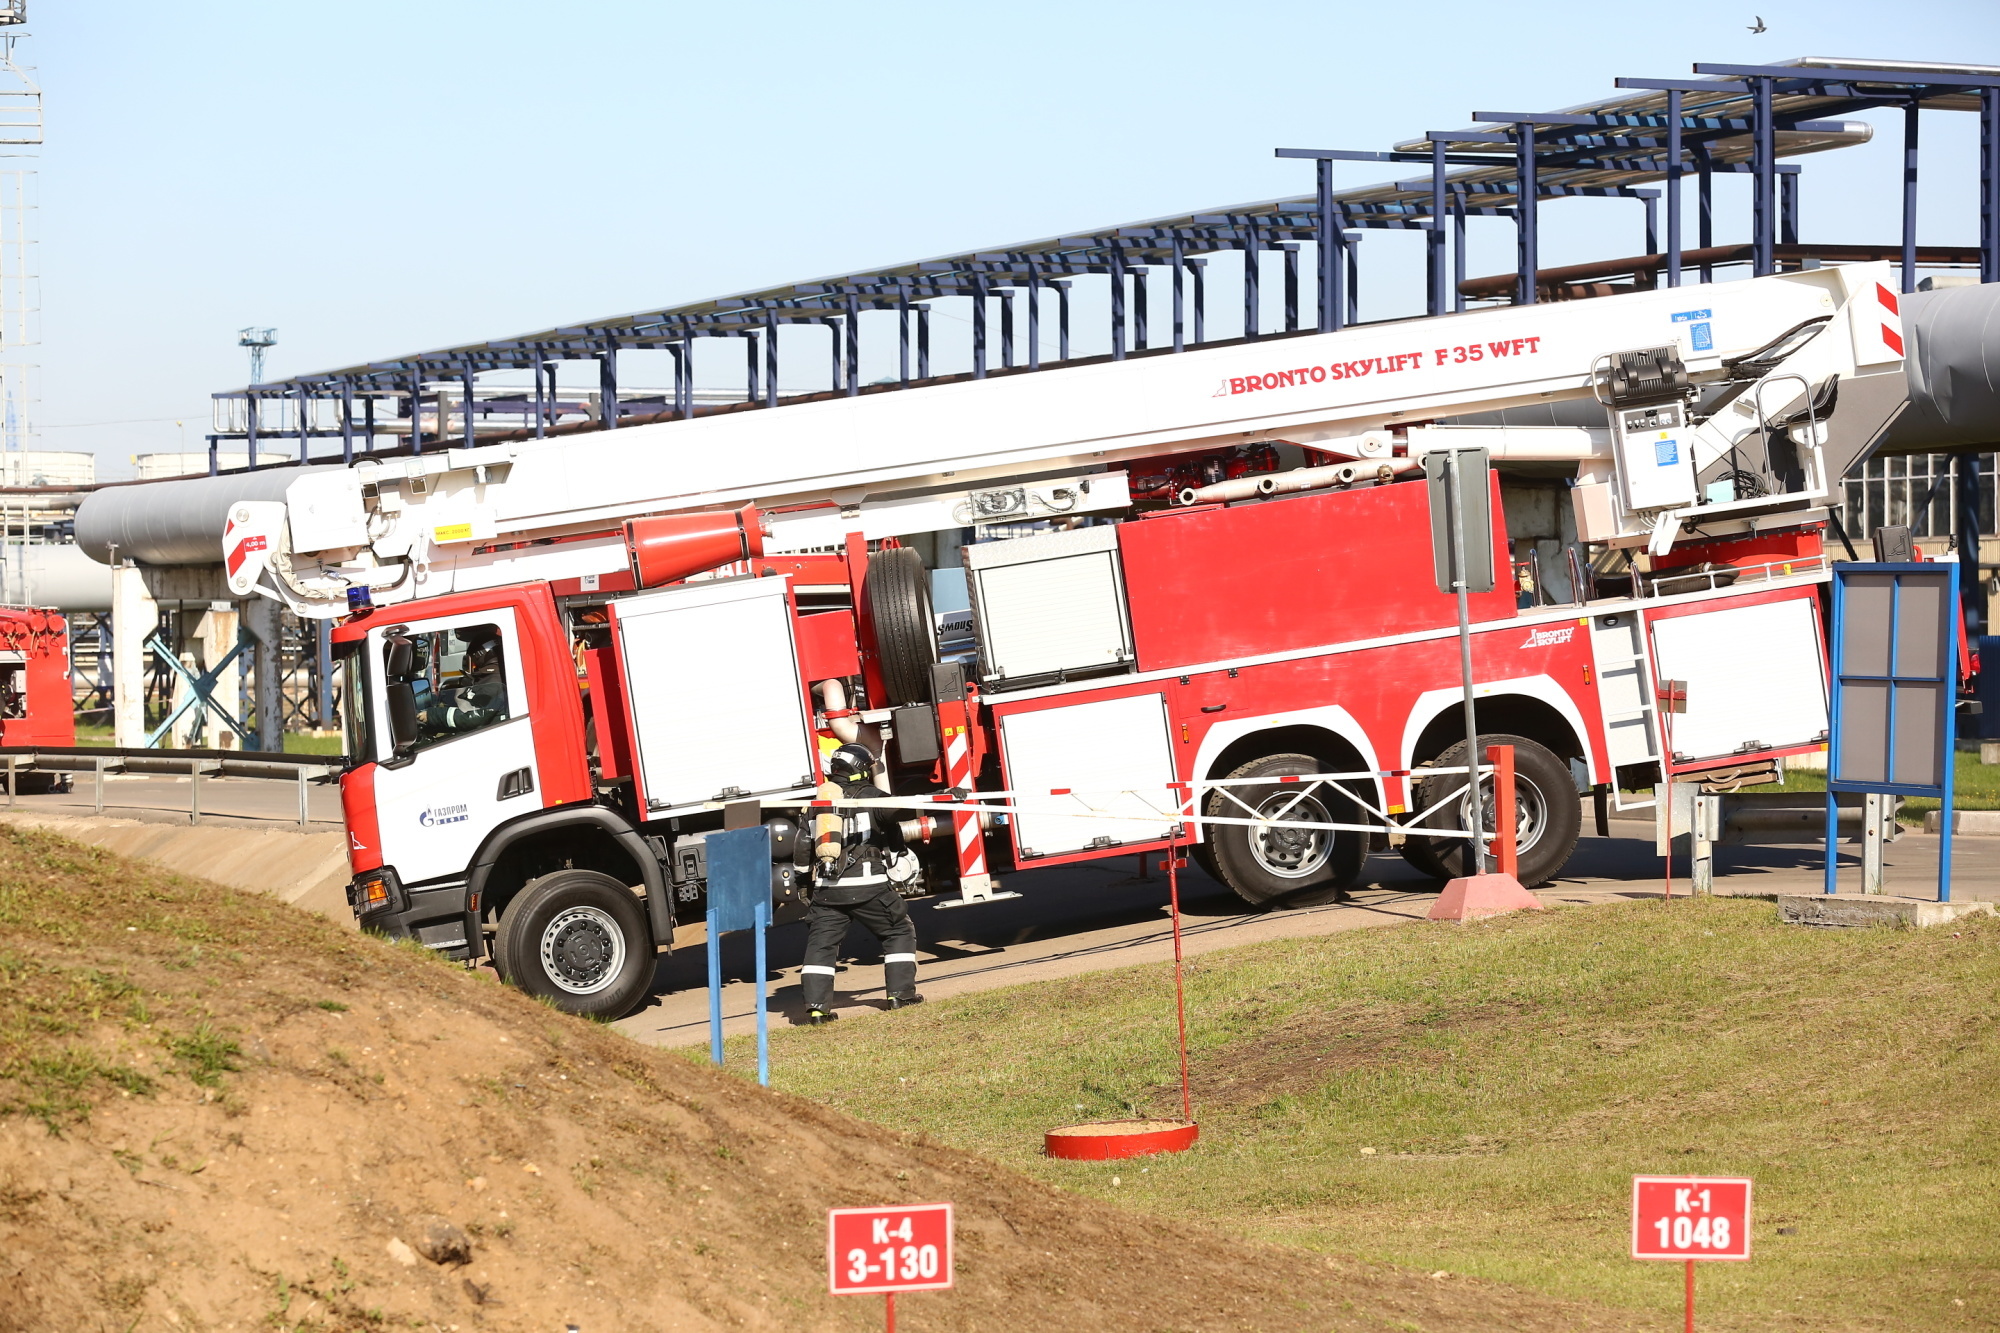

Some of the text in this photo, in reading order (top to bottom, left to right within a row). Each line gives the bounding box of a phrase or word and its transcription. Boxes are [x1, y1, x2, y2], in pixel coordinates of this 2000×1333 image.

[1229, 336, 1540, 395] BRONTO SKYLIFT F 35 WFT
[1536, 628, 1573, 639] BRONTO
[1537, 636, 1572, 646] SKYLIFT
[434, 803, 468, 818] ГАЗПРОМ
[1654, 1216, 1731, 1249] 1048
[847, 1244, 938, 1283] 3-130
